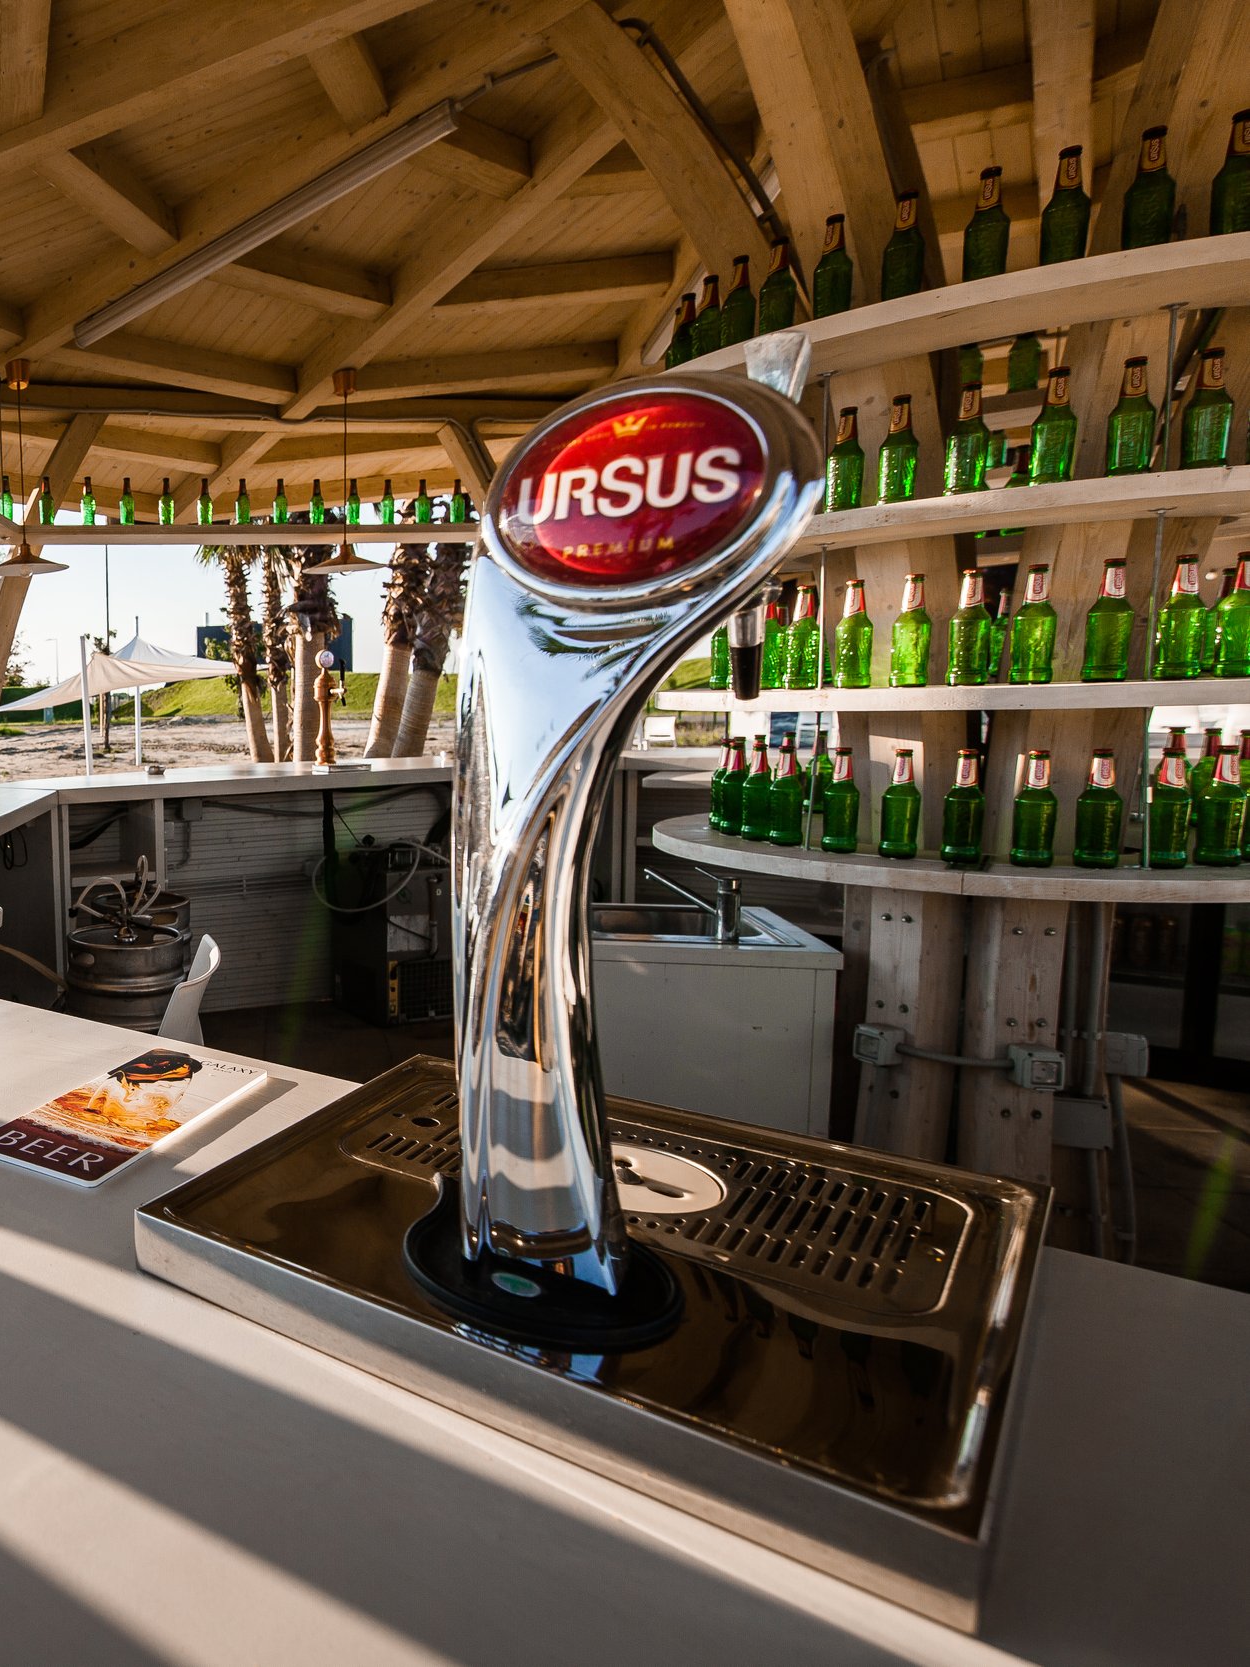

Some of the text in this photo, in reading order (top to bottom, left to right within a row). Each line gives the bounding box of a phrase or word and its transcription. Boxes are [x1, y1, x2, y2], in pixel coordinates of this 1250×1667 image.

[518, 446, 741, 525] URSUS
[562, 536, 675, 558] PREMIUM
[201, 1060, 258, 1074] GALAXY
